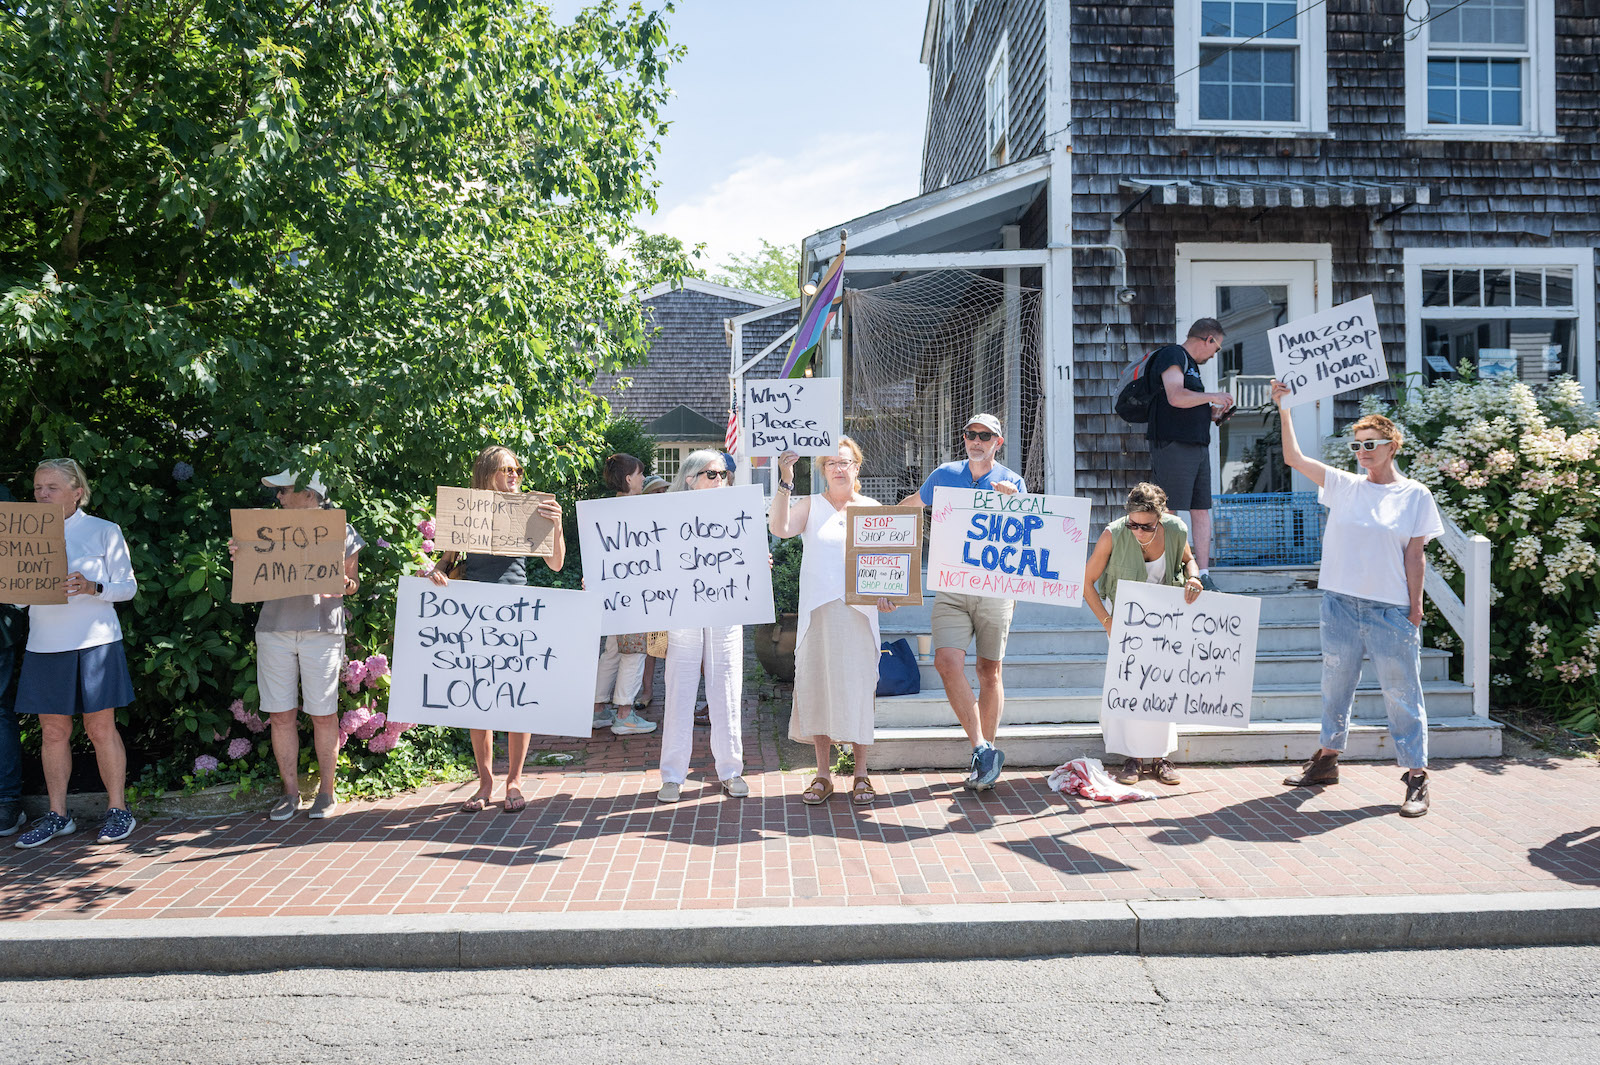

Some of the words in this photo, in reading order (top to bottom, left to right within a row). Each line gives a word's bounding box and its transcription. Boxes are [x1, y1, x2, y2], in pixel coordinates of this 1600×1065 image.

[1278, 315, 1364, 353] Amazon
[1057, 365, 1070, 380] 11
[1281, 370, 1308, 396] Go
[1316, 353, 1370, 382] Home
[750, 383, 804, 414] Why?
[751, 412, 819, 431] Please
[752, 431, 789, 451] Buy
[793, 431, 831, 447] local
[456, 497, 520, 515] SUPPORT
[973, 490, 994, 509] BE
[998, 494, 1053, 515] VOCAL
[0, 512, 55, 535] SHOP
[453, 515, 501, 531] LOCAL
[595, 520, 668, 552] What
[679, 510, 753, 541] about
[864, 516, 894, 528] STOP
[966, 512, 1044, 547] SHOP
[0, 540, 58, 557] SMALL
[253, 526, 329, 553] STOP
[451, 530, 535, 548] BUSINESSES
[858, 530, 886, 542] SHOP
[889, 530, 911, 542] BOP
[17, 557, 53, 574] DON'T
[601, 549, 662, 581] Local
[860, 555, 901, 566] SUPPORT
[962, 540, 1060, 580] LOCAL
[253, 561, 340, 586] AMAZON
[860, 580, 881, 590] SHOP
[883, 582, 904, 591] LOCAL
[889, 569, 905, 580] POP
[418, 591, 546, 632] Boycott
[641, 588, 679, 617] pay
[418, 626, 473, 654] Shop
[480, 626, 538, 656] Bop
[1119, 632, 1143, 653] to
[1152, 634, 1184, 655] the
[1191, 638, 1242, 664] island
[432, 647, 558, 683] Support
[1118, 653, 1136, 682] if
[1140, 664, 1174, 690] you
[1178, 659, 1226, 686] don't
[422, 673, 539, 712] LOCAL
[1143, 692, 1178, 713] about
[1184, 693, 1244, 718] Islanders
